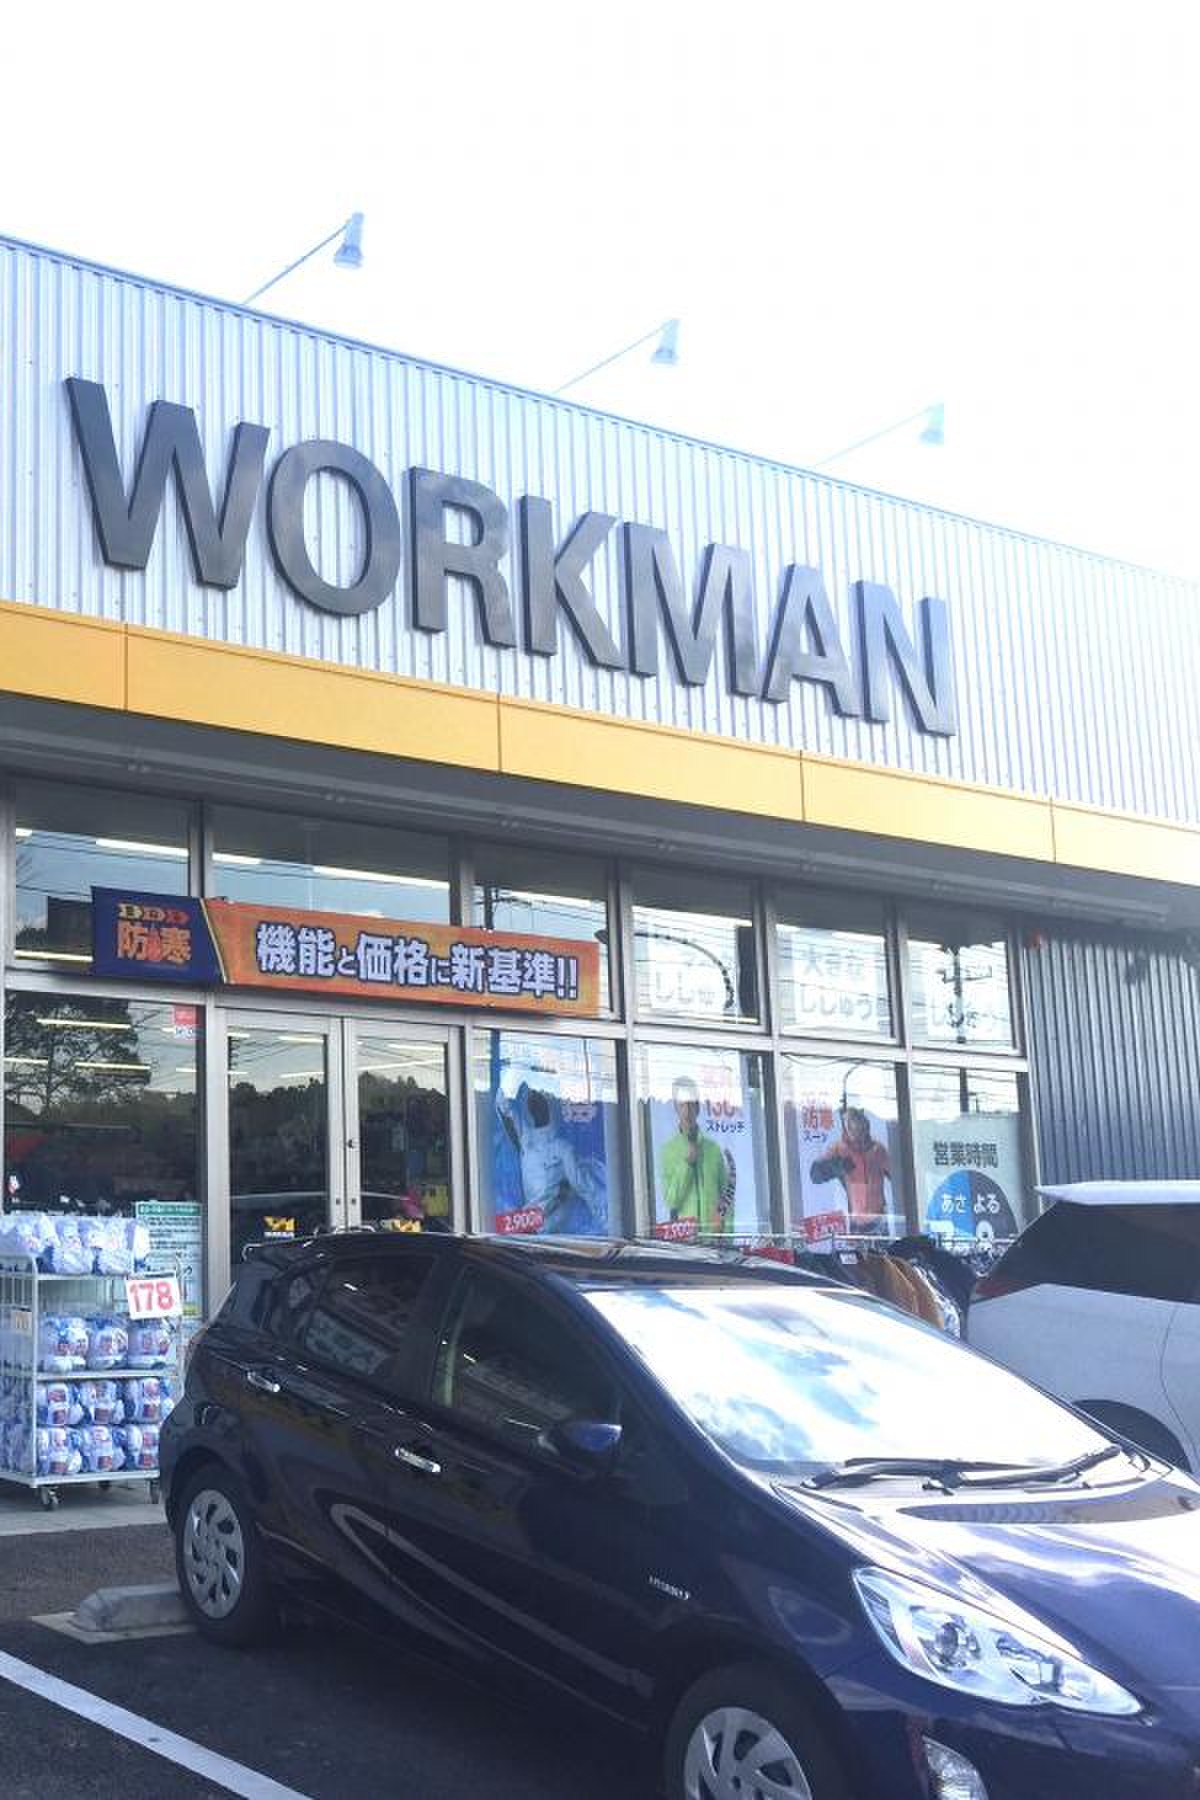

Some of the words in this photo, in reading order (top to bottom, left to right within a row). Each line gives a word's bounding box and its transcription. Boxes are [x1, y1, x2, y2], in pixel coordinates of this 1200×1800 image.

[65, 376, 956, 736] WORKMAN
[933, 1141, 998, 1169] 営業時間
[942, 1193, 967, 1214] あさ
[974, 1193, 1000, 1214] よる
[129, 1281, 175, 1313] 178
